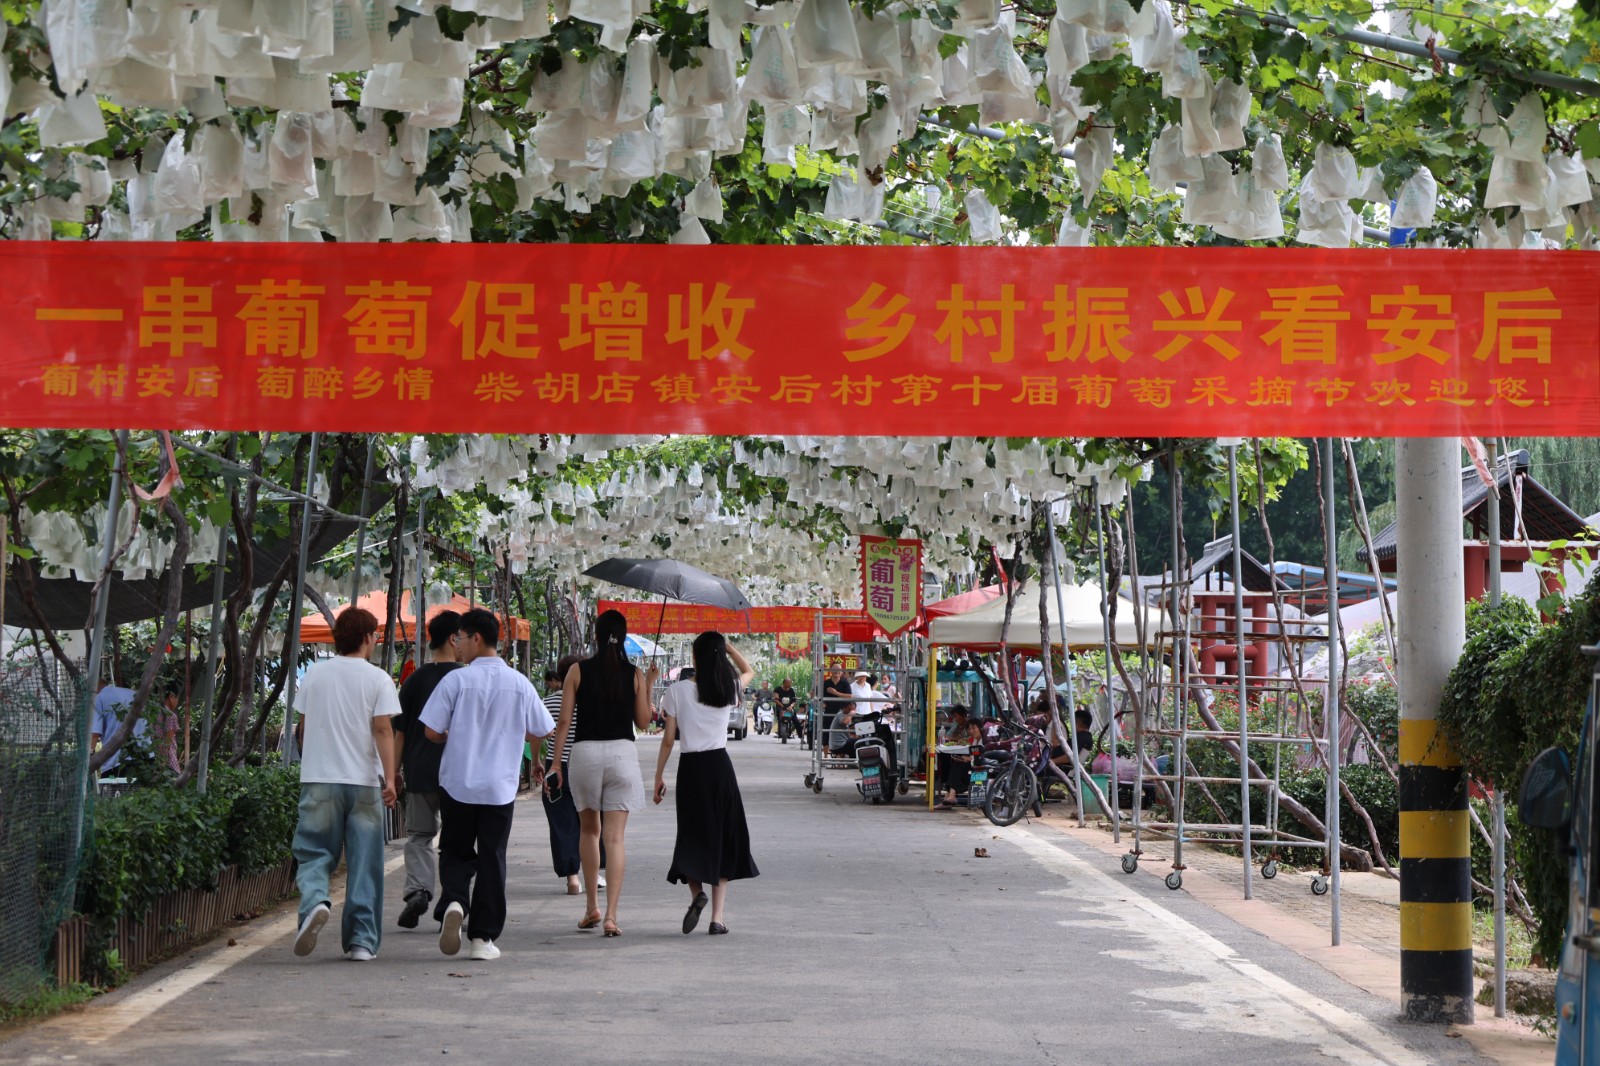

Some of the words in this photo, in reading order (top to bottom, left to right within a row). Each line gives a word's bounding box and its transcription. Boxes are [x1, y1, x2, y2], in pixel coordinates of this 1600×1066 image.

[35, 276, 756, 362] 一串葡萄促增收
[843, 281, 1563, 366] 乡村振兴看安后
[41, 363, 223, 398] 葡村安后
[256, 366, 435, 400] 萄醉乡情
[870, 558, 896, 613] 葡萄
[607, 607, 737, 622] 果为媒促振兴
